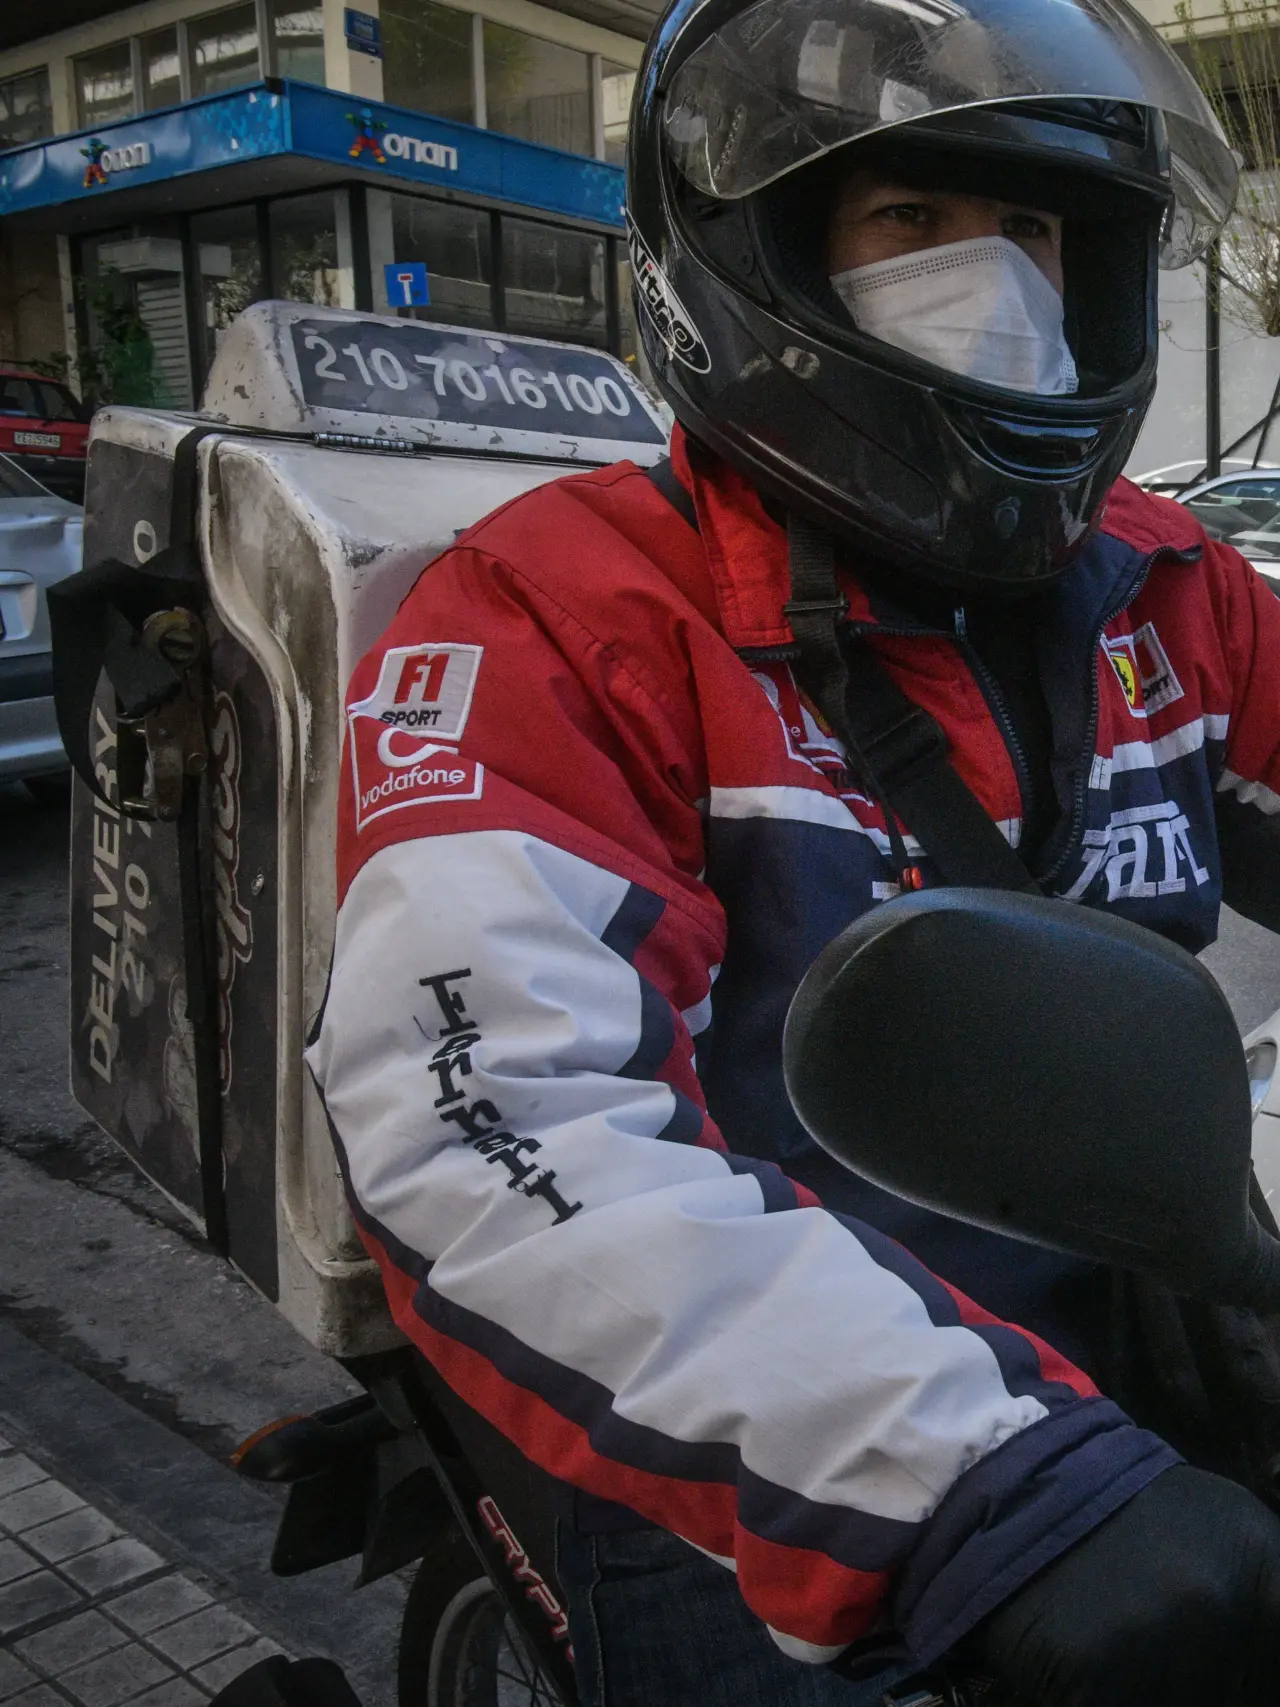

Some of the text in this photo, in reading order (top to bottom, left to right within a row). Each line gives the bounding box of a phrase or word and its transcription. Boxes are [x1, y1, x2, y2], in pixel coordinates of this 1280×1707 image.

[627, 226, 697, 353] Nitro
[304, 334, 631, 417] 210 7016100
[380, 709, 441, 727] SPORT
[394, 653, 449, 704] F1
[360, 765, 466, 809] vodafone
[89, 706, 122, 1084] DELIVERY
[120, 862, 151, 1004] 210
[479, 1494, 575, 1661] CRYPT
